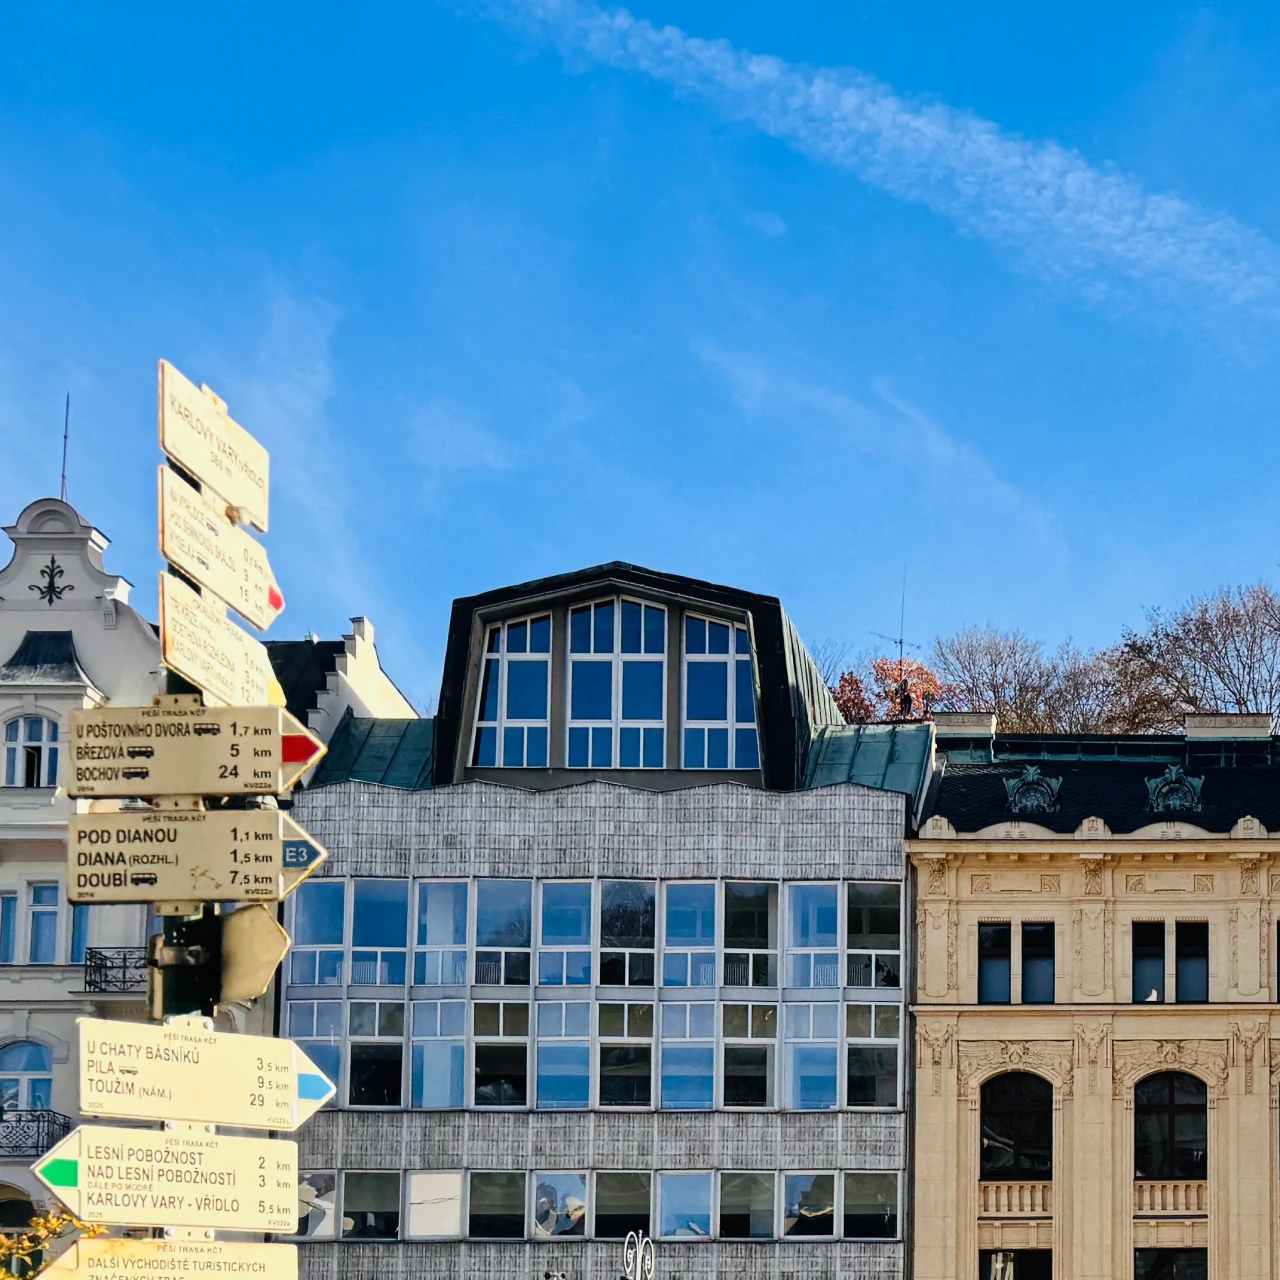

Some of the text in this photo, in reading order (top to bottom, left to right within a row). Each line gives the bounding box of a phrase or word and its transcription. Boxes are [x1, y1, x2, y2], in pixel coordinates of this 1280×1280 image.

[170, 394, 215, 446] KARLOVY
[216, 436, 238, 465] VARY
[240, 586, 249, 602] 15
[77, 721, 191, 739] U POŠTOVNÍHO DVORA
[230, 722, 272, 738] 1,7 km
[76, 742, 125, 760] BŘEZOVÁ
[230, 743, 272, 758] 5 km
[76, 767, 120, 781] BOCHOV
[219, 764, 272, 779] 24 km
[78, 828, 178, 844] POD DIANOU
[230, 827, 273, 843] 1,1 km
[77, 851, 179, 867] DIANA (ROZHL.)
[230, 848, 273, 865] 1,5 km
[285, 848, 308, 862] E3
[77, 869, 127, 888] DOUBÍ
[229, 870, 273, 886] 7,5 km
[87, 1041, 200, 1064] U CHATY BÁSNÍKŮ
[87, 1059, 115, 1075] PILA
[257, 1058, 289, 1073] 3,5 km
[87, 1077, 172, 1101] TOUŽIM (NÁM.)
[257, 1076, 289, 1091] 9,5 km
[250, 1093, 289, 1109] 29 km
[87, 1144, 204, 1166] LESNÍ POBOŽNOST
[258, 1156, 290, 1171] 2 km
[87, 1165, 236, 1186] NAD LESNÍ POBOŽNOSTÍ
[259, 1175, 291, 1189] 3 km
[88, 1181, 109, 1190] DÁLE
[112, 1182, 123, 1190] PO
[87, 1192, 147, 1208] KARLOVY
[151, 1195, 184, 1210] VARY
[196, 1195, 240, 1212] VŘÍDLO
[258, 1201, 291, 1215] 5,5 km
[178, 1246, 205, 1254] TRASA
[207, 1246, 223, 1254] KČT
[88, 1257, 266, 1272] DALŠÍ VÝCHODIŠTĚ TURISTICKÝCH
